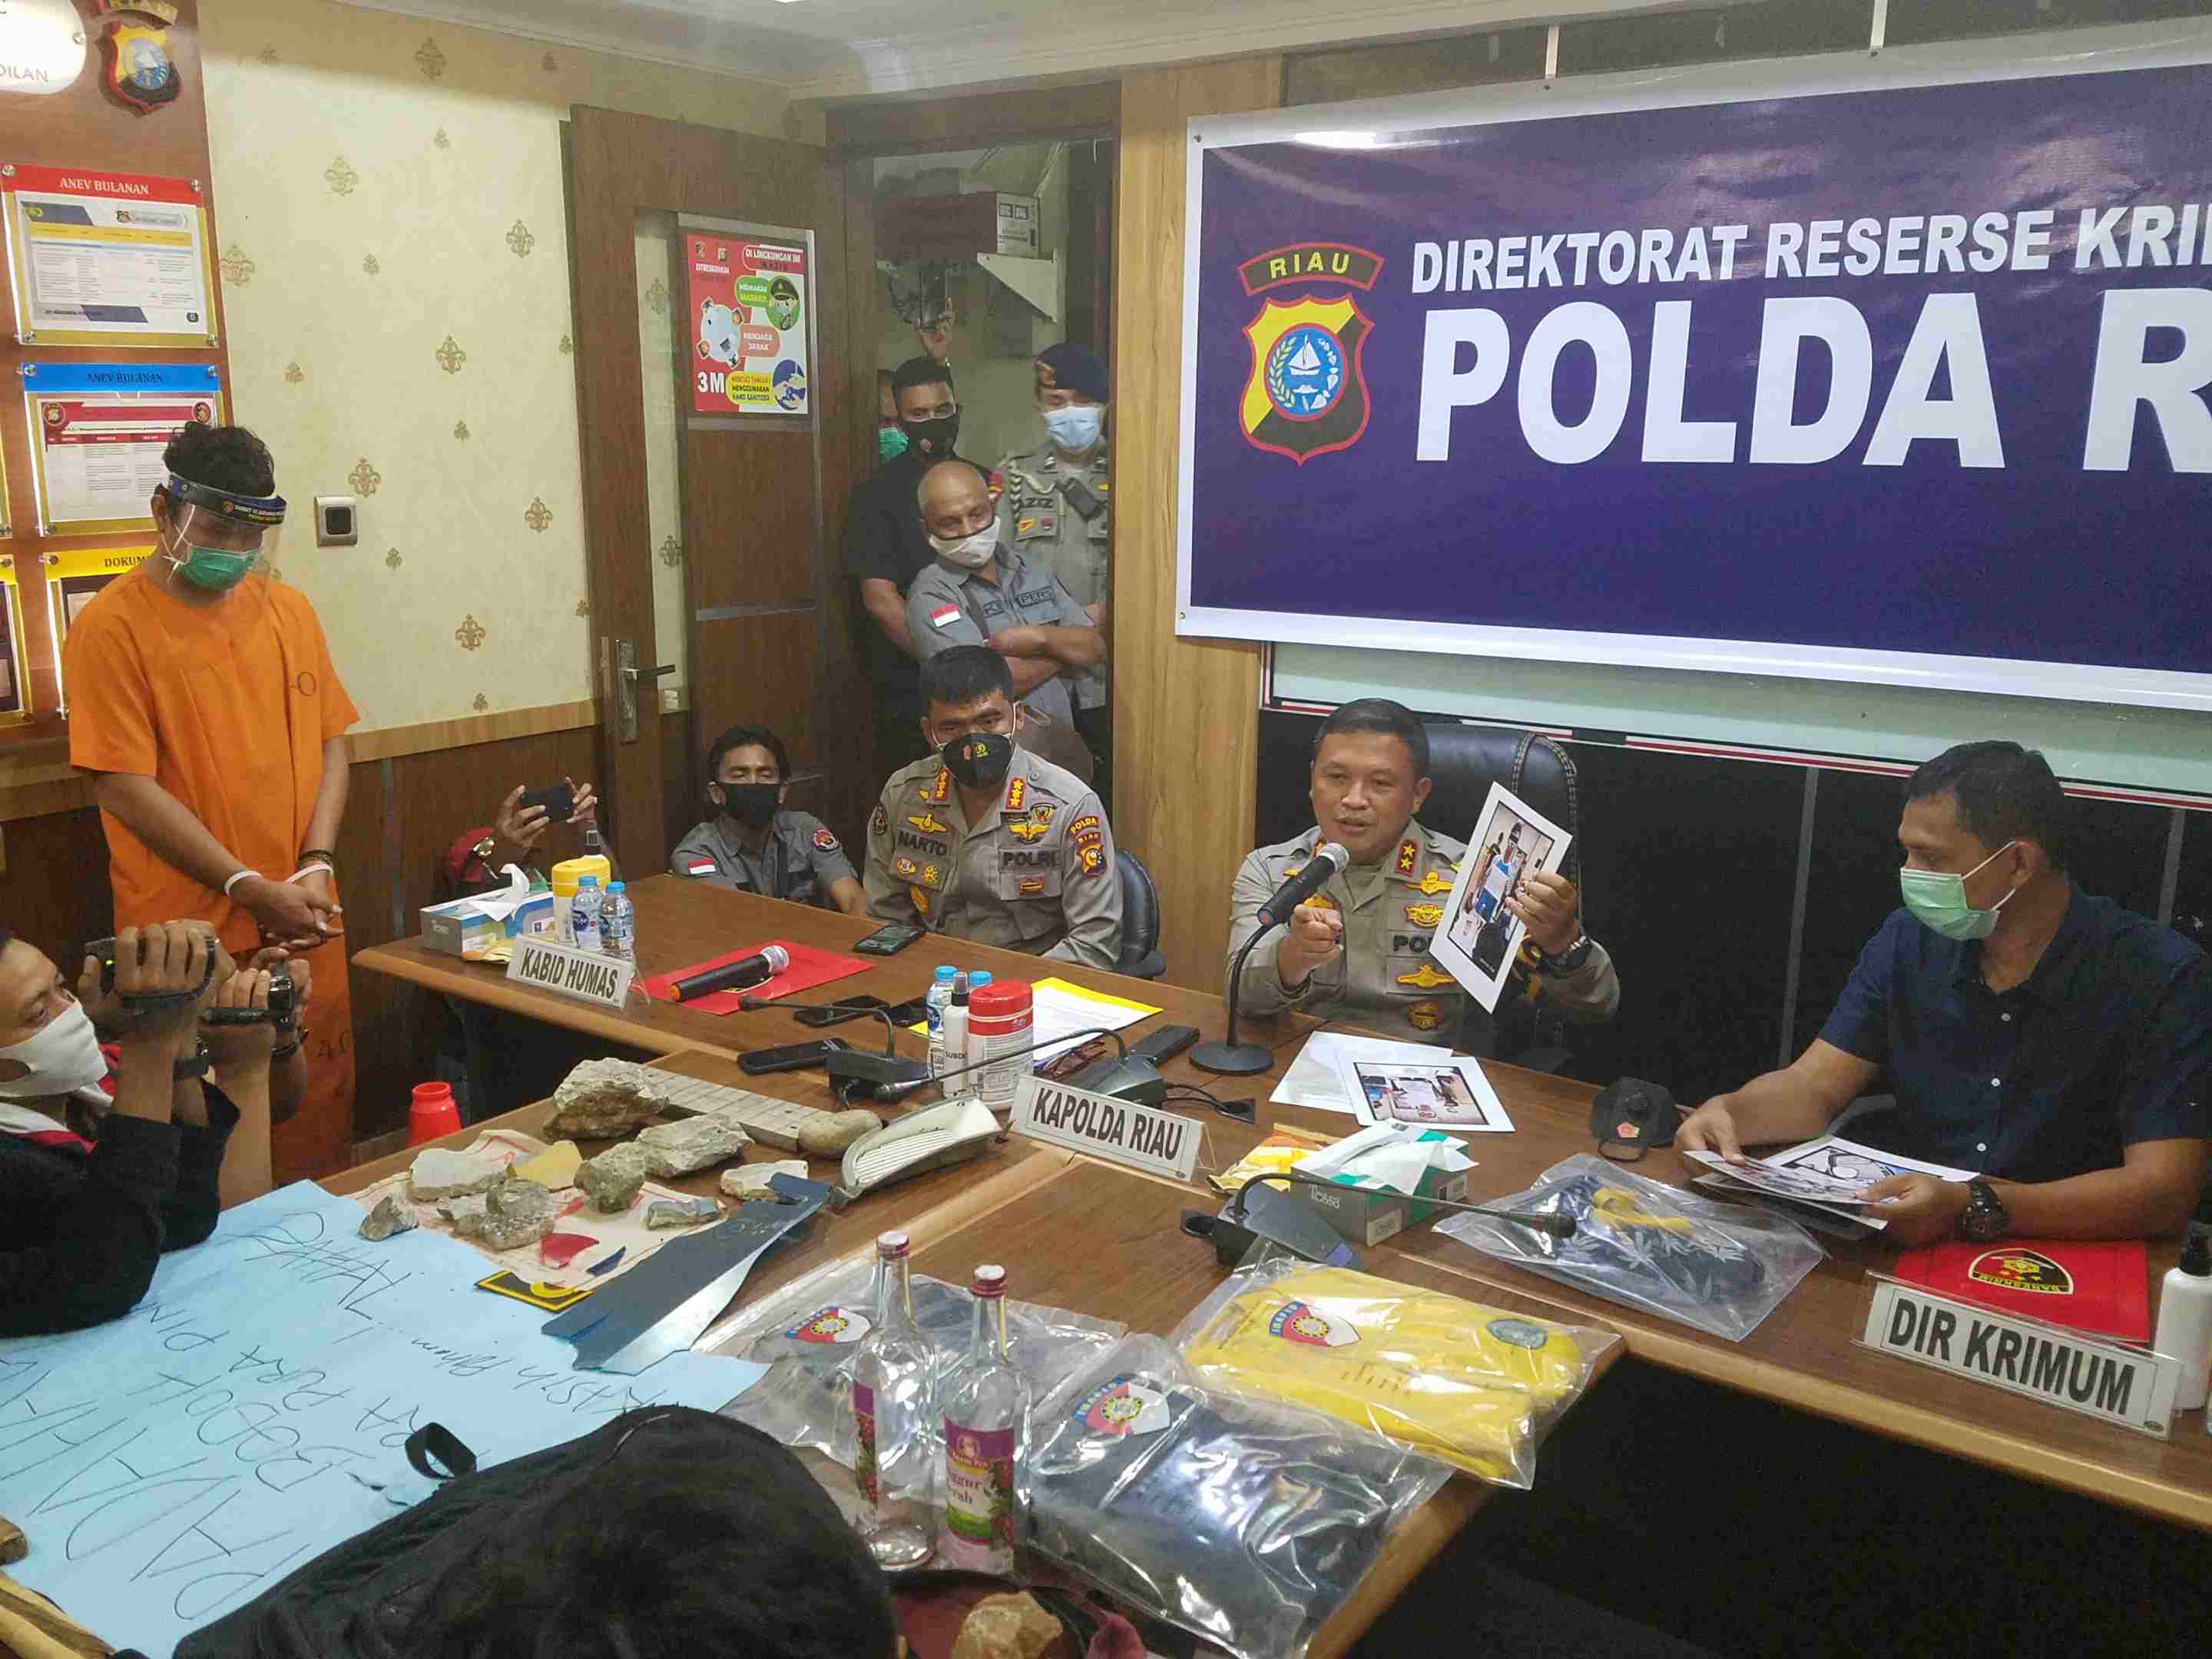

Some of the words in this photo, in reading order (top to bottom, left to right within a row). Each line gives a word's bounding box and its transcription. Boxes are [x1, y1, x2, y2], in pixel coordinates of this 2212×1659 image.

[60, 177, 91, 190] ANEV
[94, 181, 148, 195] BULANAN
[1269, 250, 1350, 280] RIAU
[1412, 224, 1748, 293] DIREKTORAT
[1765, 210, 2055, 280] RESERSE
[2075, 203, 2212, 269] KRI
[86, 373, 113, 382] ANEV
[117, 373, 164, 383] BULANAN
[1416, 292, 2006, 469] POLDA
[104, 555, 145, 568] DOKUM
[521, 947, 566, 986] KABID
[567, 959, 618, 999] HUMAS
[1033, 1087, 1127, 1147] KAPOLDA
[1128, 1112, 1184, 1161] RIAU
[1888, 1297, 1958, 1362] DIR
[1963, 1319, 2135, 1416] KRIMUM
